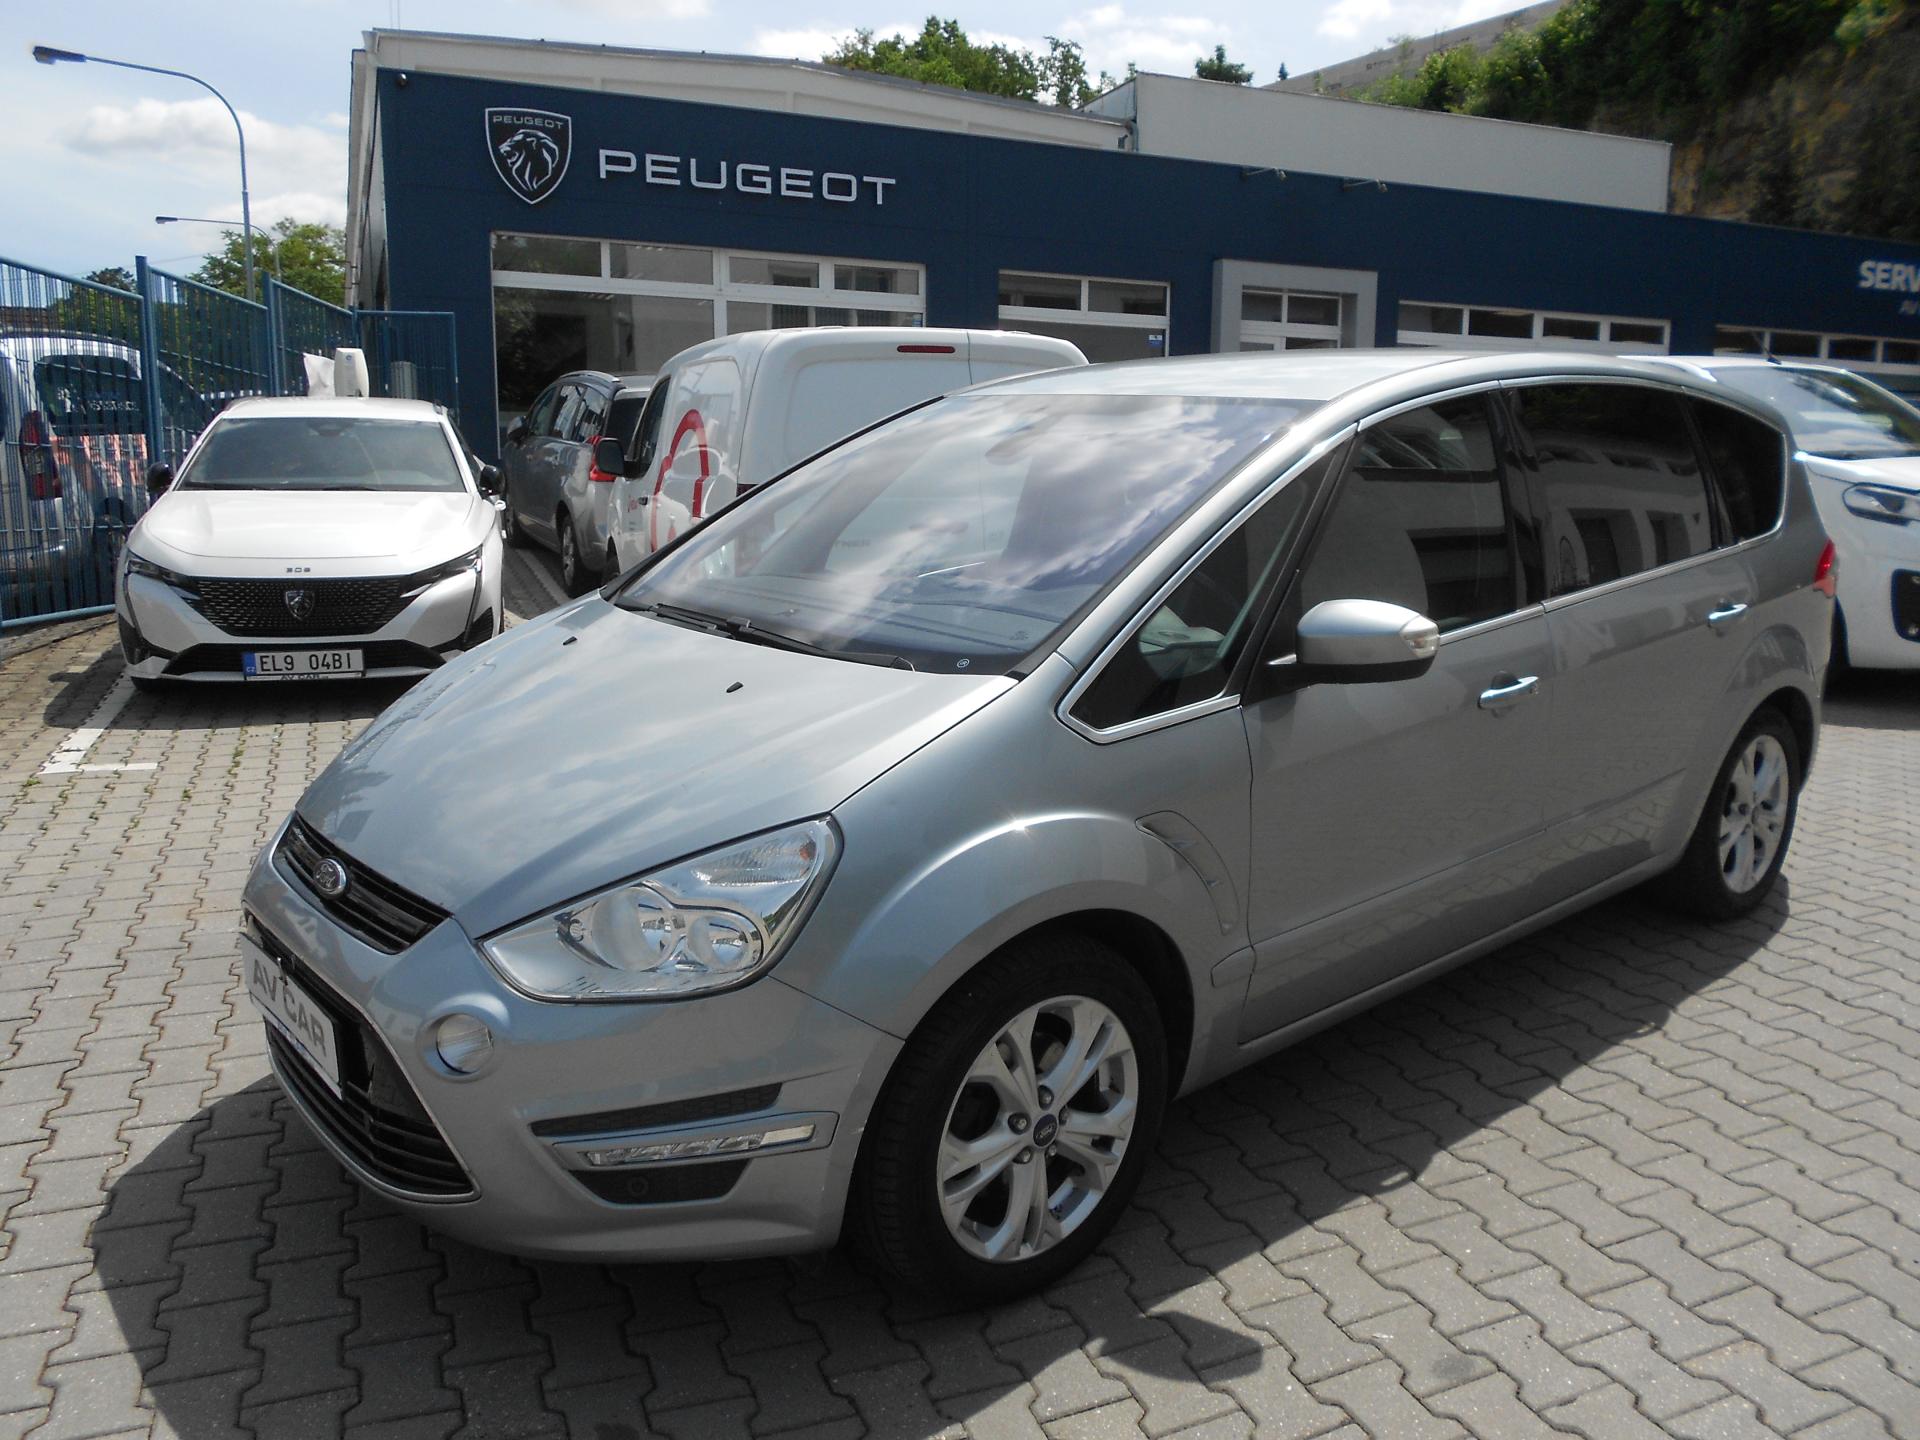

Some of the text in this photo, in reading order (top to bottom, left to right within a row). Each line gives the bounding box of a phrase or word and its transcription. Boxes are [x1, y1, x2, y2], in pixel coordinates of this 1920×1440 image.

[492, 114, 564, 130] PEUGEOT
[599, 148, 897, 206] PEUGEOT
[259, 652, 352, 672] EL9 04BI
[282, 984, 327, 1057] CAR
